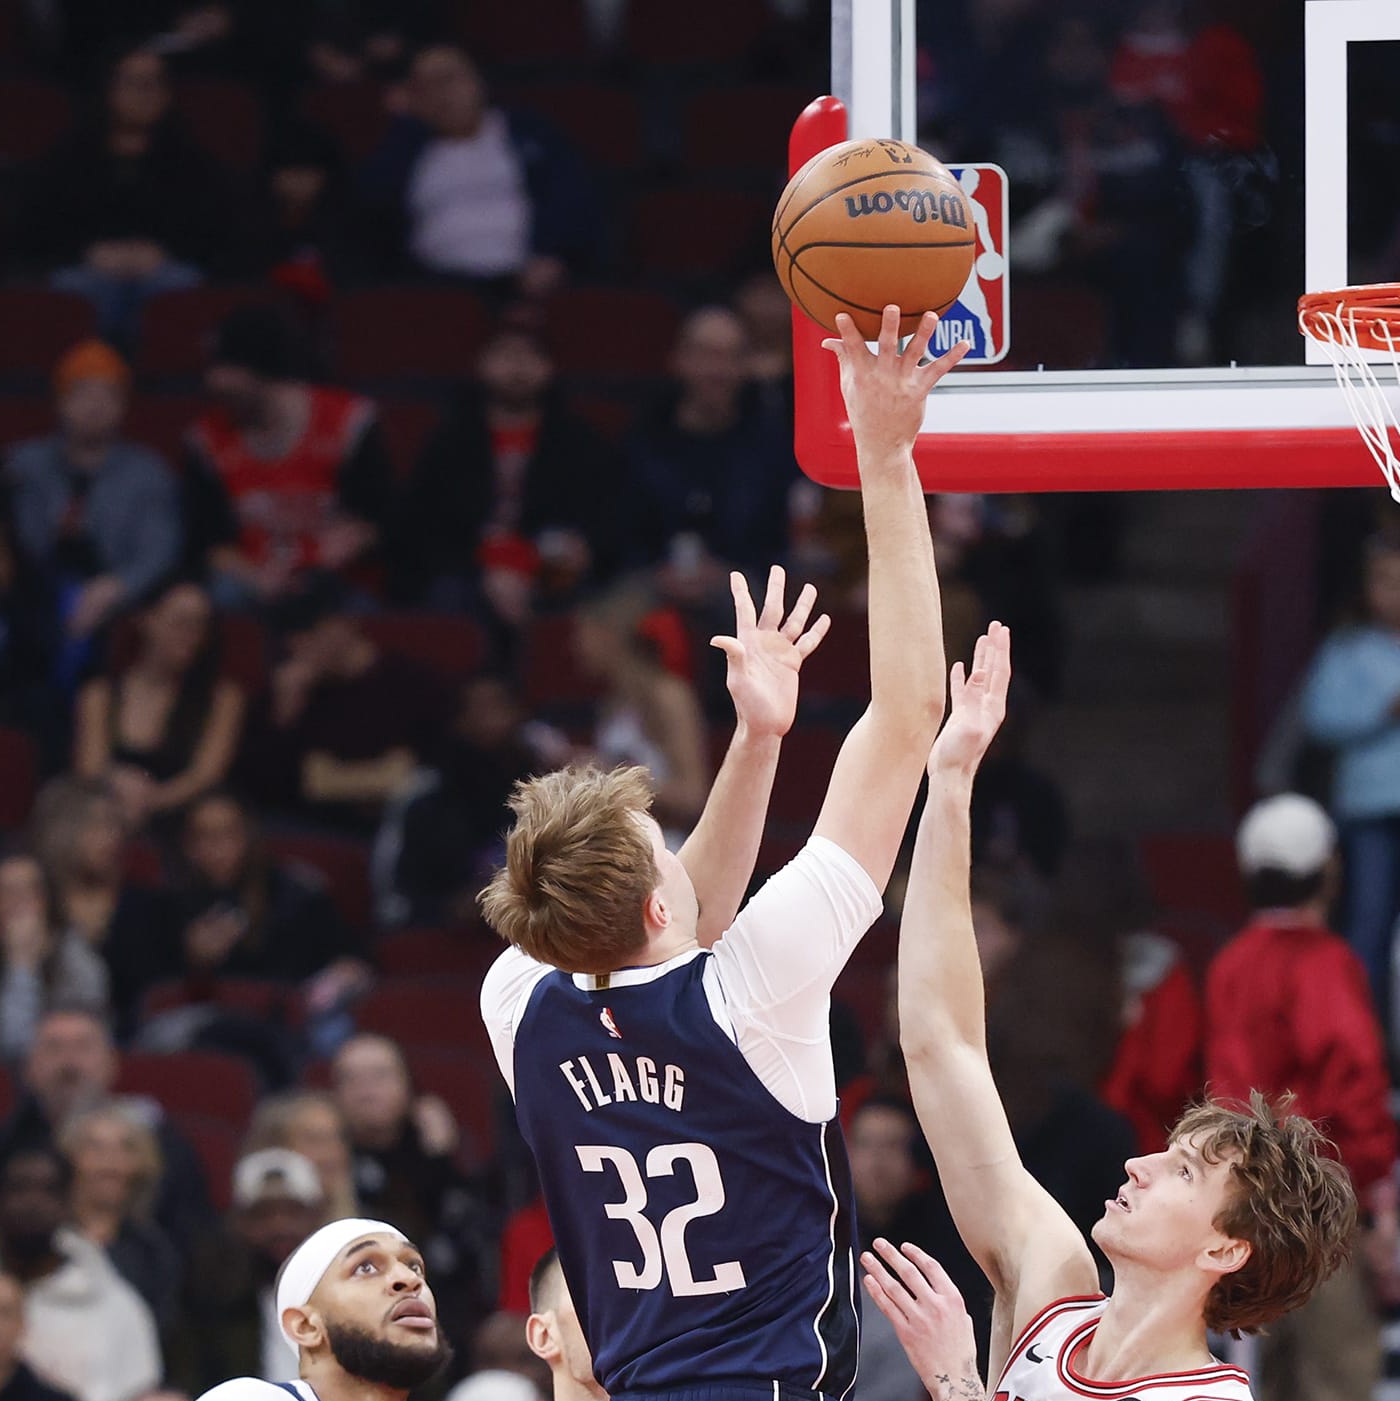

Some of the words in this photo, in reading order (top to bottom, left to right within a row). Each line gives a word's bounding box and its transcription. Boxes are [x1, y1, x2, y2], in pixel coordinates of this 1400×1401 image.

[844, 189, 968, 229] Wilson
[935, 318, 976, 351] NBA
[559, 1053, 685, 1112] FLAGG
[574, 1142, 747, 1297] 32
